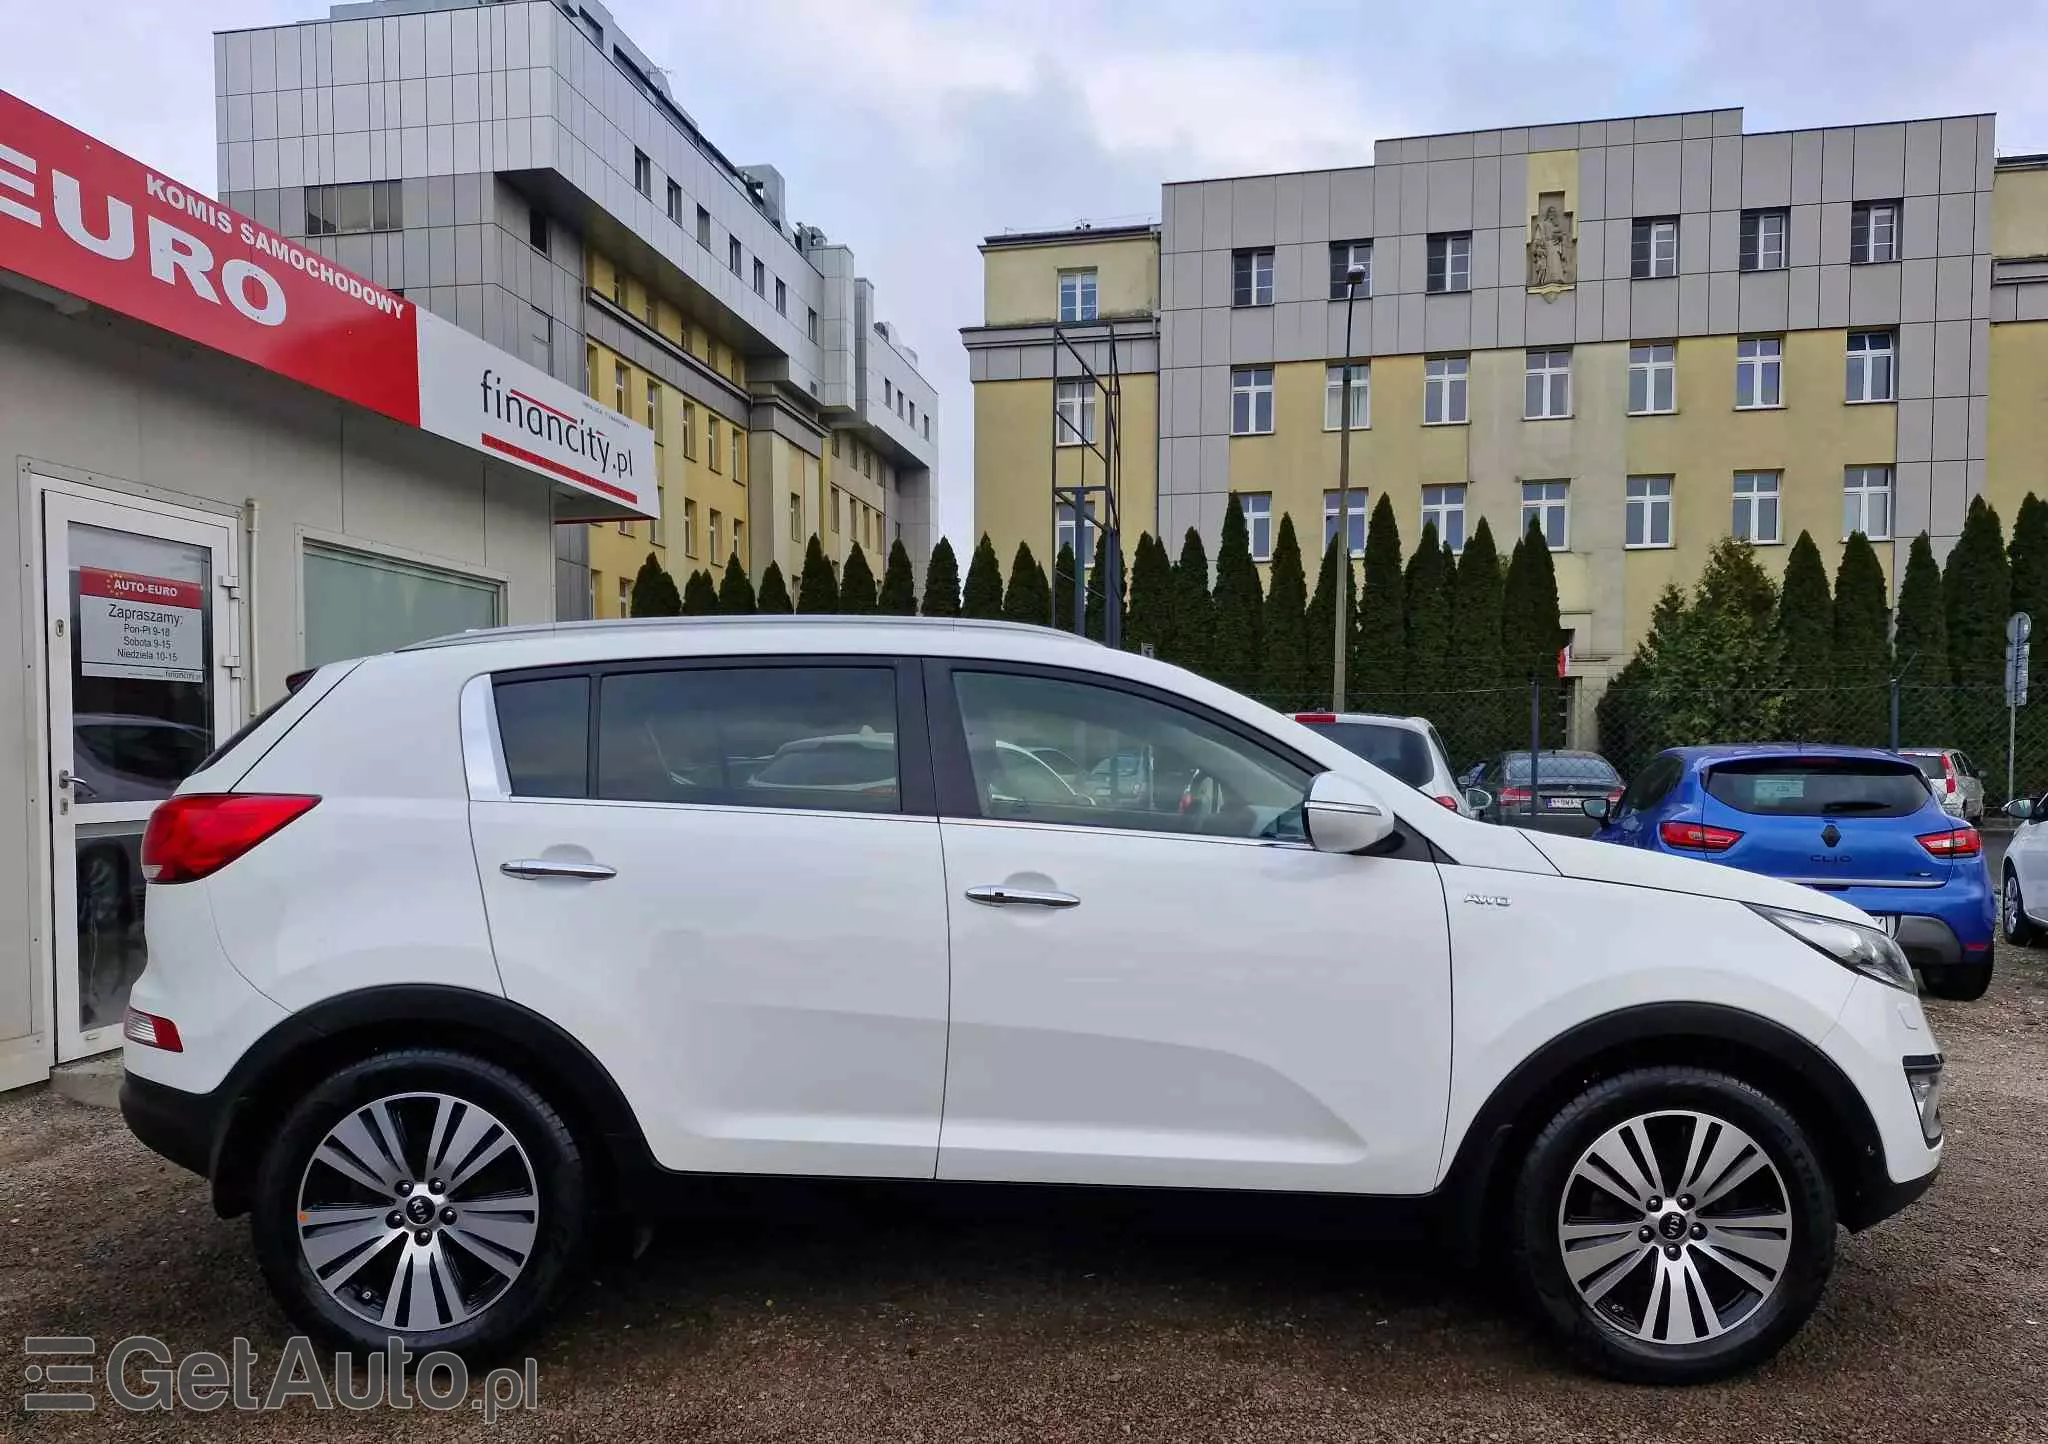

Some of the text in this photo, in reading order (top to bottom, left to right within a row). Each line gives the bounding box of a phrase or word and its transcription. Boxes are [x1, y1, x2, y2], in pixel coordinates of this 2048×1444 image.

[146, 173, 405, 319] KOMIS SAMOCHODOWY
[481, 369, 633, 479] financity.pl
[114, 580, 178, 597] AUTO-EURO
[123, 636, 152, 648] Sobota
[117, 648, 153, 660] Niedziela
[1810, 854, 1853, 863] CLIO
[1463, 895, 1512, 907] AWD
